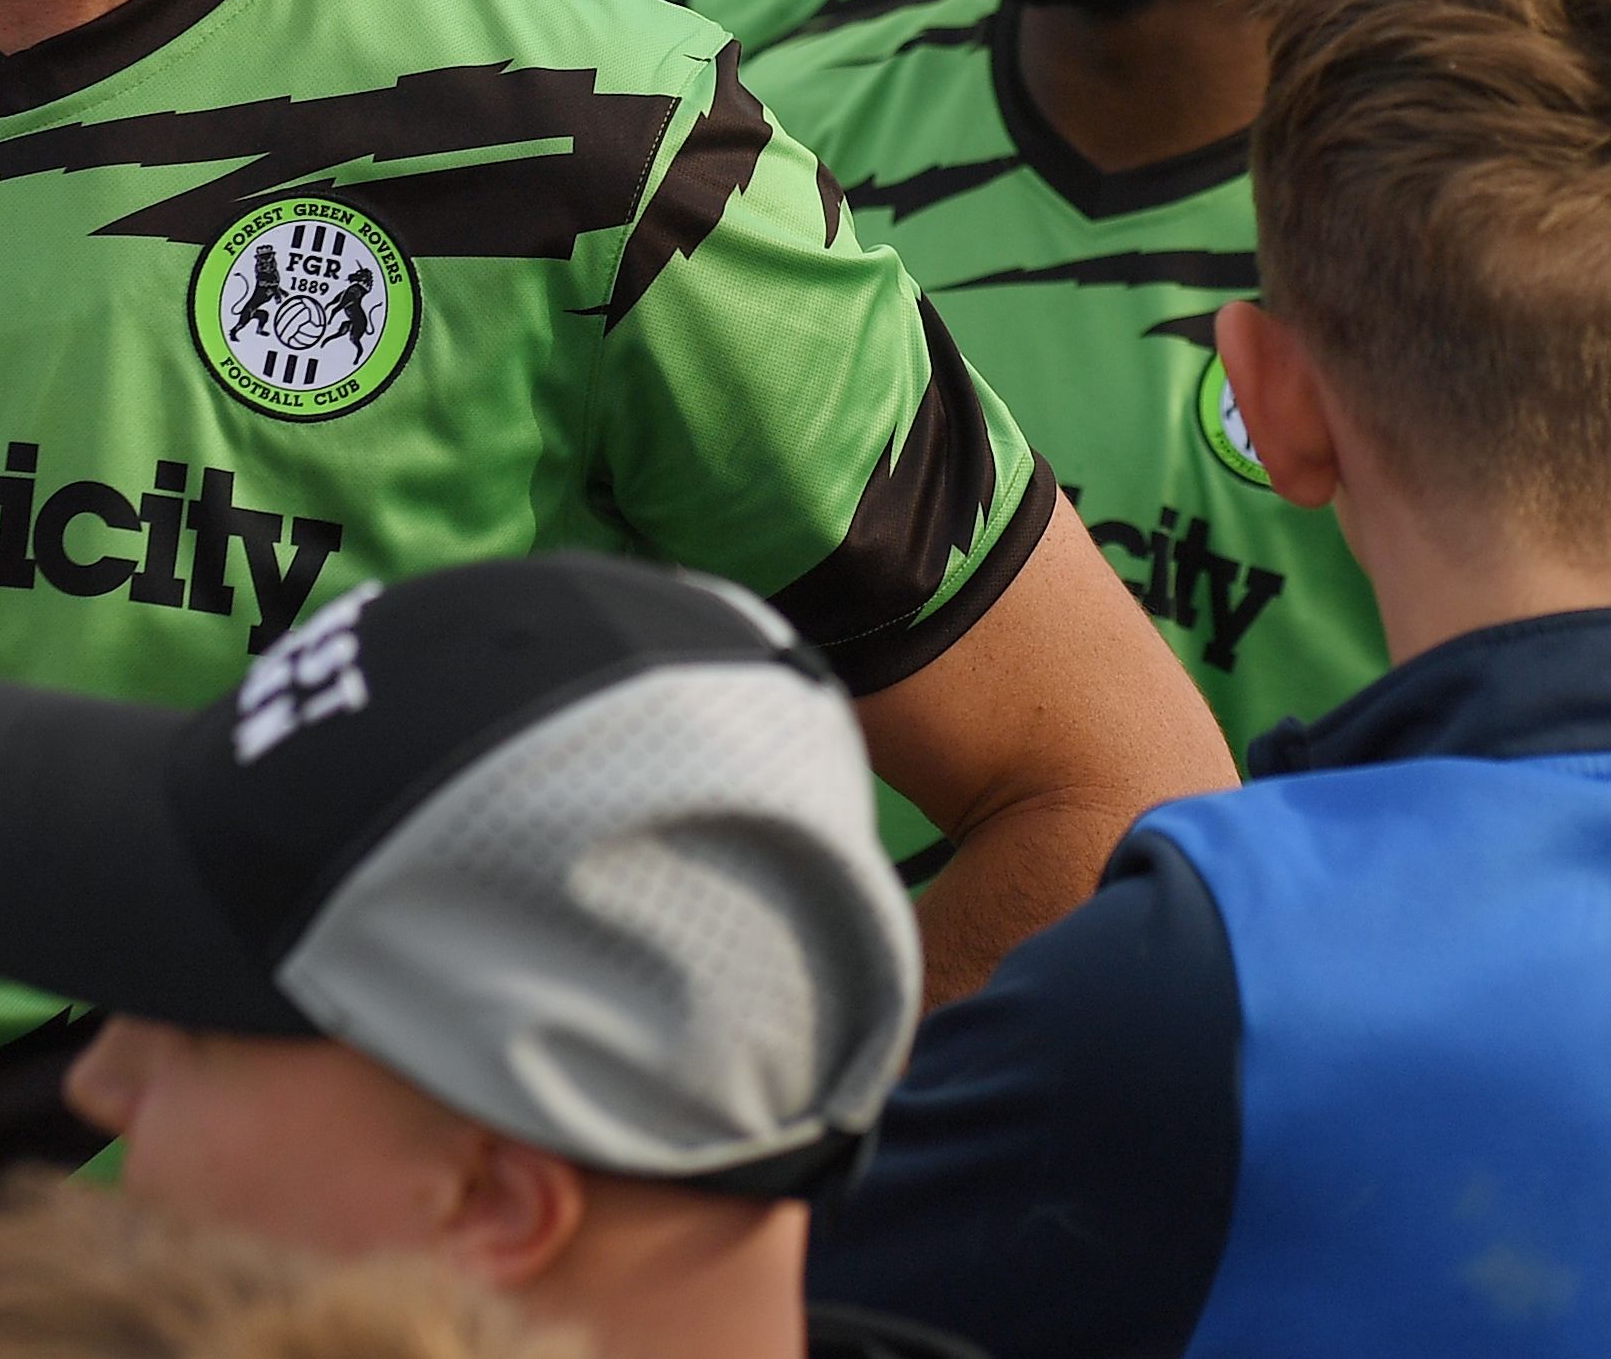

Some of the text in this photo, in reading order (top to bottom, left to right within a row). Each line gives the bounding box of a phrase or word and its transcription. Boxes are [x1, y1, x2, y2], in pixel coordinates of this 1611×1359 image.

[224, 203, 403, 285] FOREST GREEN ROVERS
[286, 252, 342, 280] FGR
[290, 277, 330, 296] 1889
[220, 357, 361, 407] FOOTBALL CLUB
